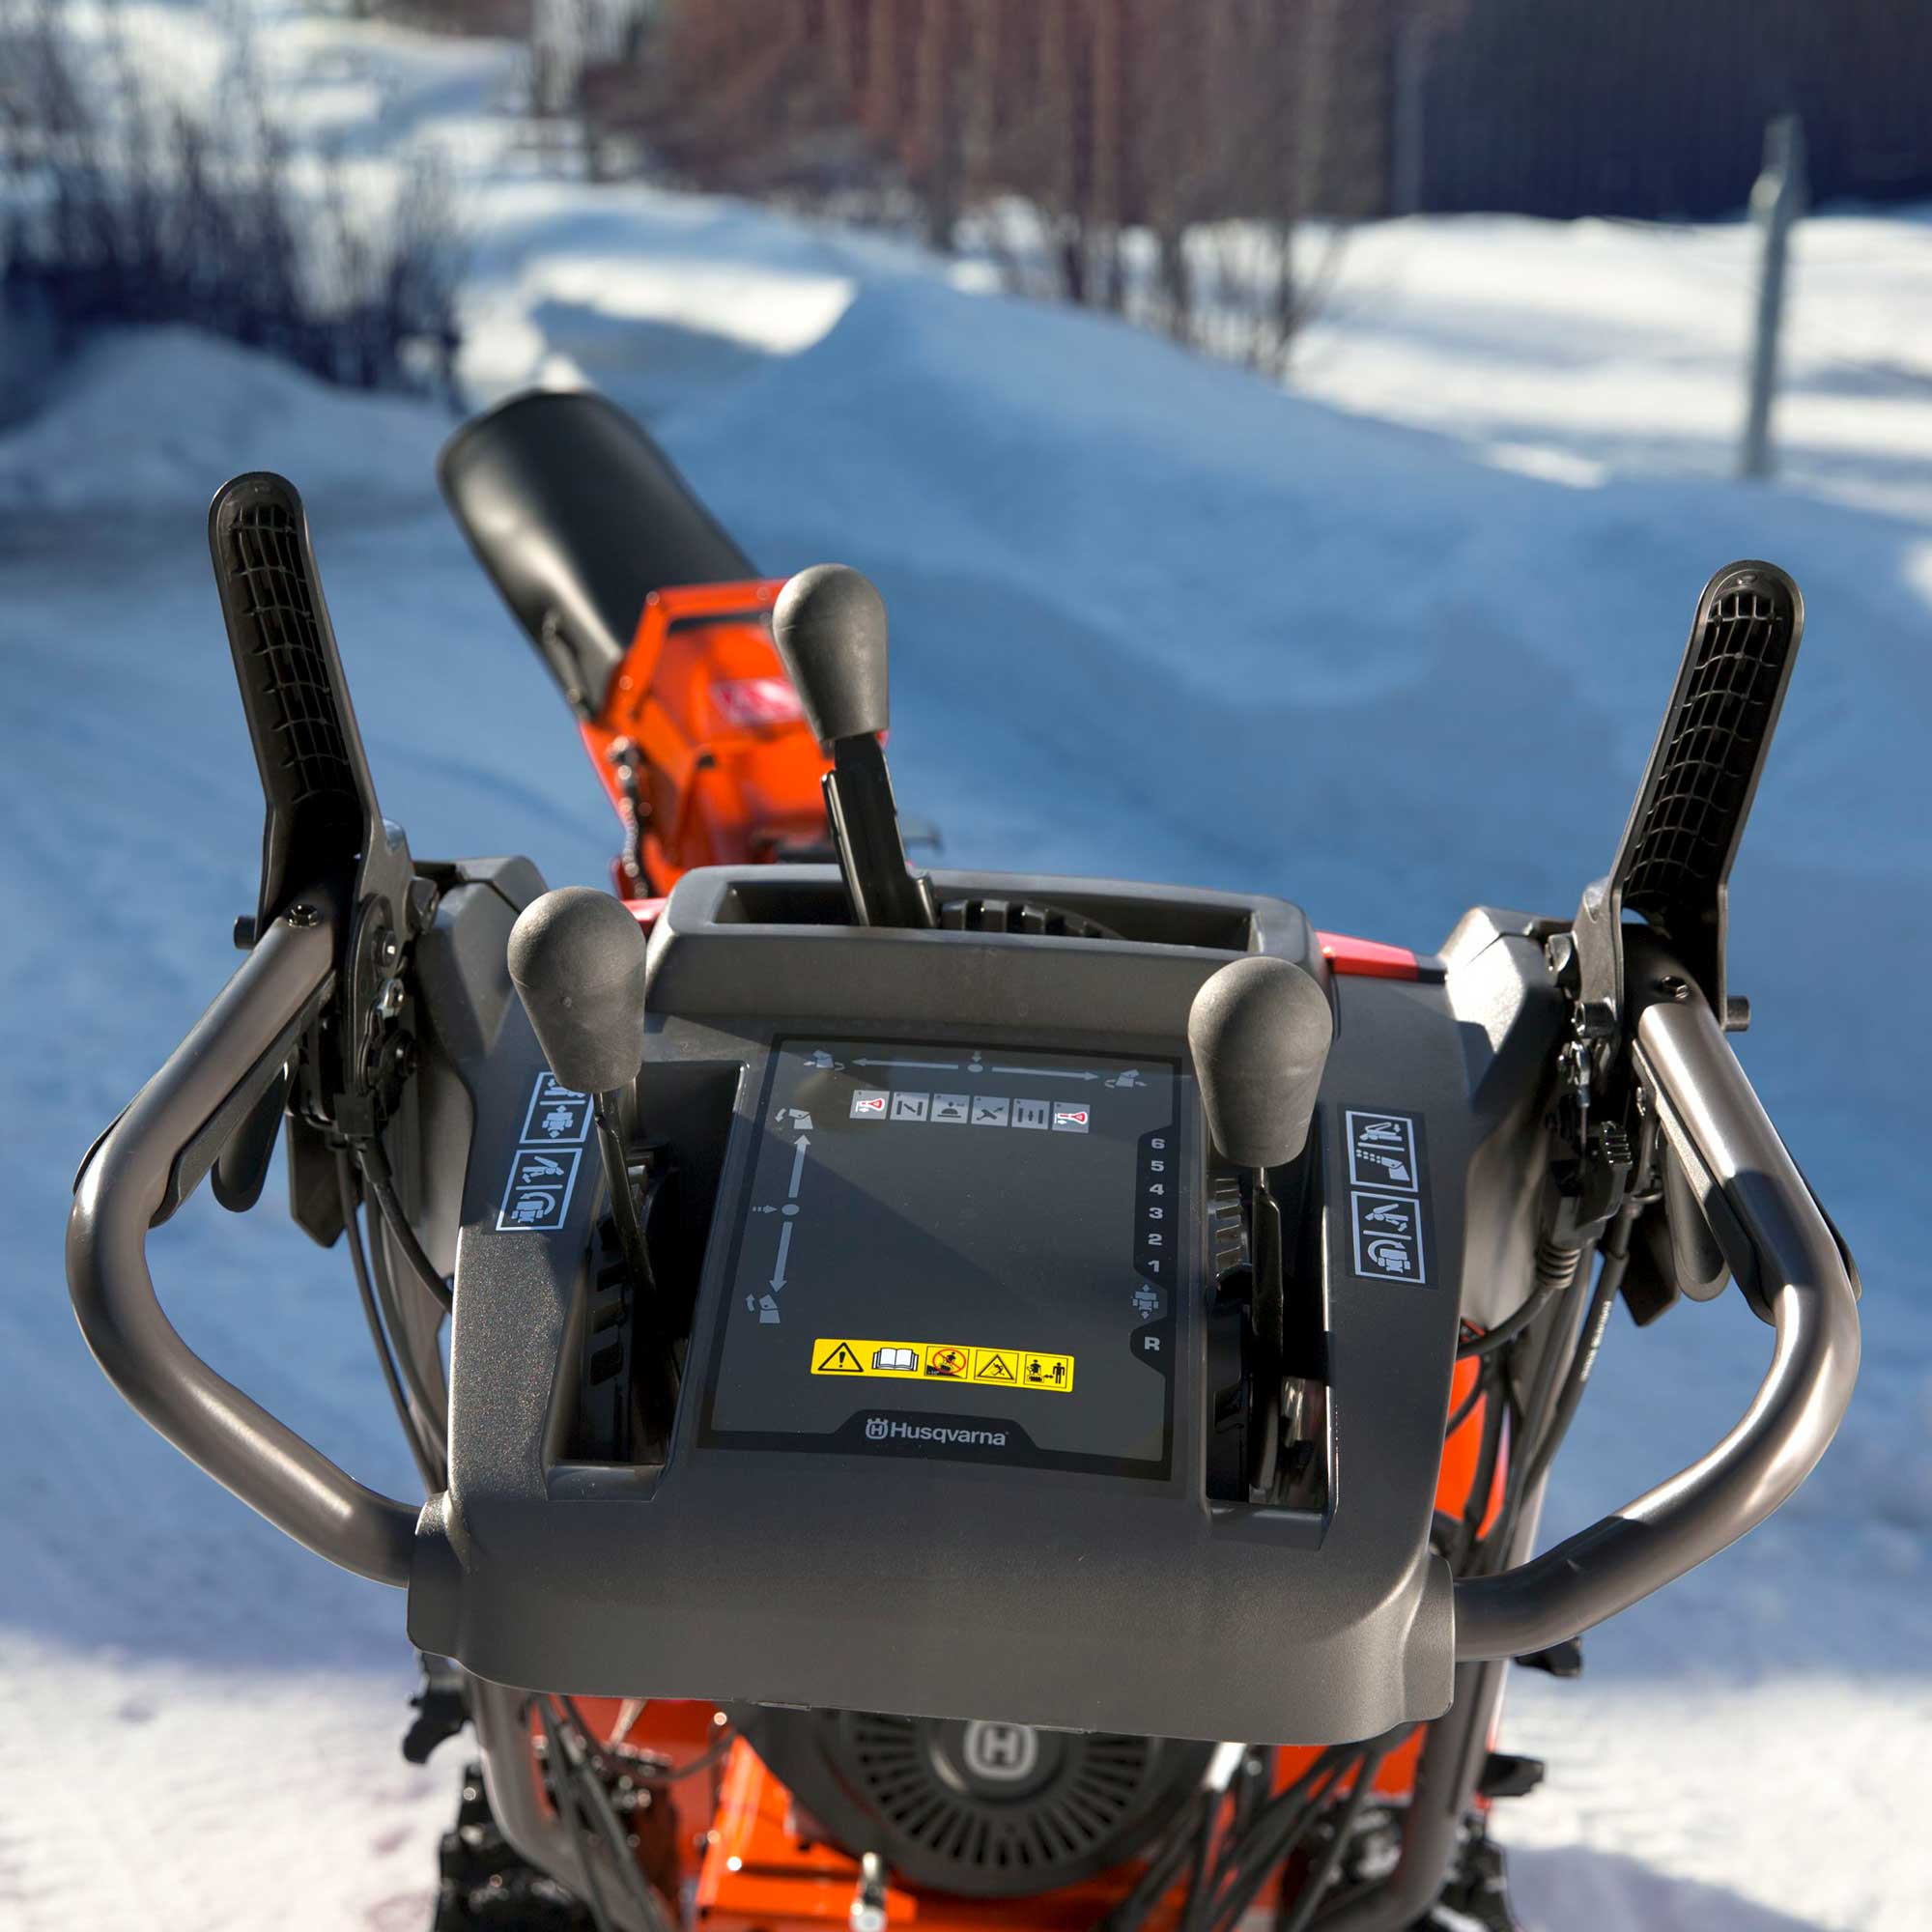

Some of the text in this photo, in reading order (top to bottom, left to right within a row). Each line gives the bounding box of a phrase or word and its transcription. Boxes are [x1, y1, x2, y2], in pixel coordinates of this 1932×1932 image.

[1151, 1138, 1165, 1150] 6
[1151, 1160, 1164, 1172] 5
[1149, 1183, 1164, 1195] 4
[1149, 1207, 1163, 1219] 3
[1148, 1234, 1162, 1245] 2
[1148, 1260, 1159, 1272] 1
[1144, 1336, 1160, 1350] R
[890, 1421, 1006, 1446] Husqvarna
